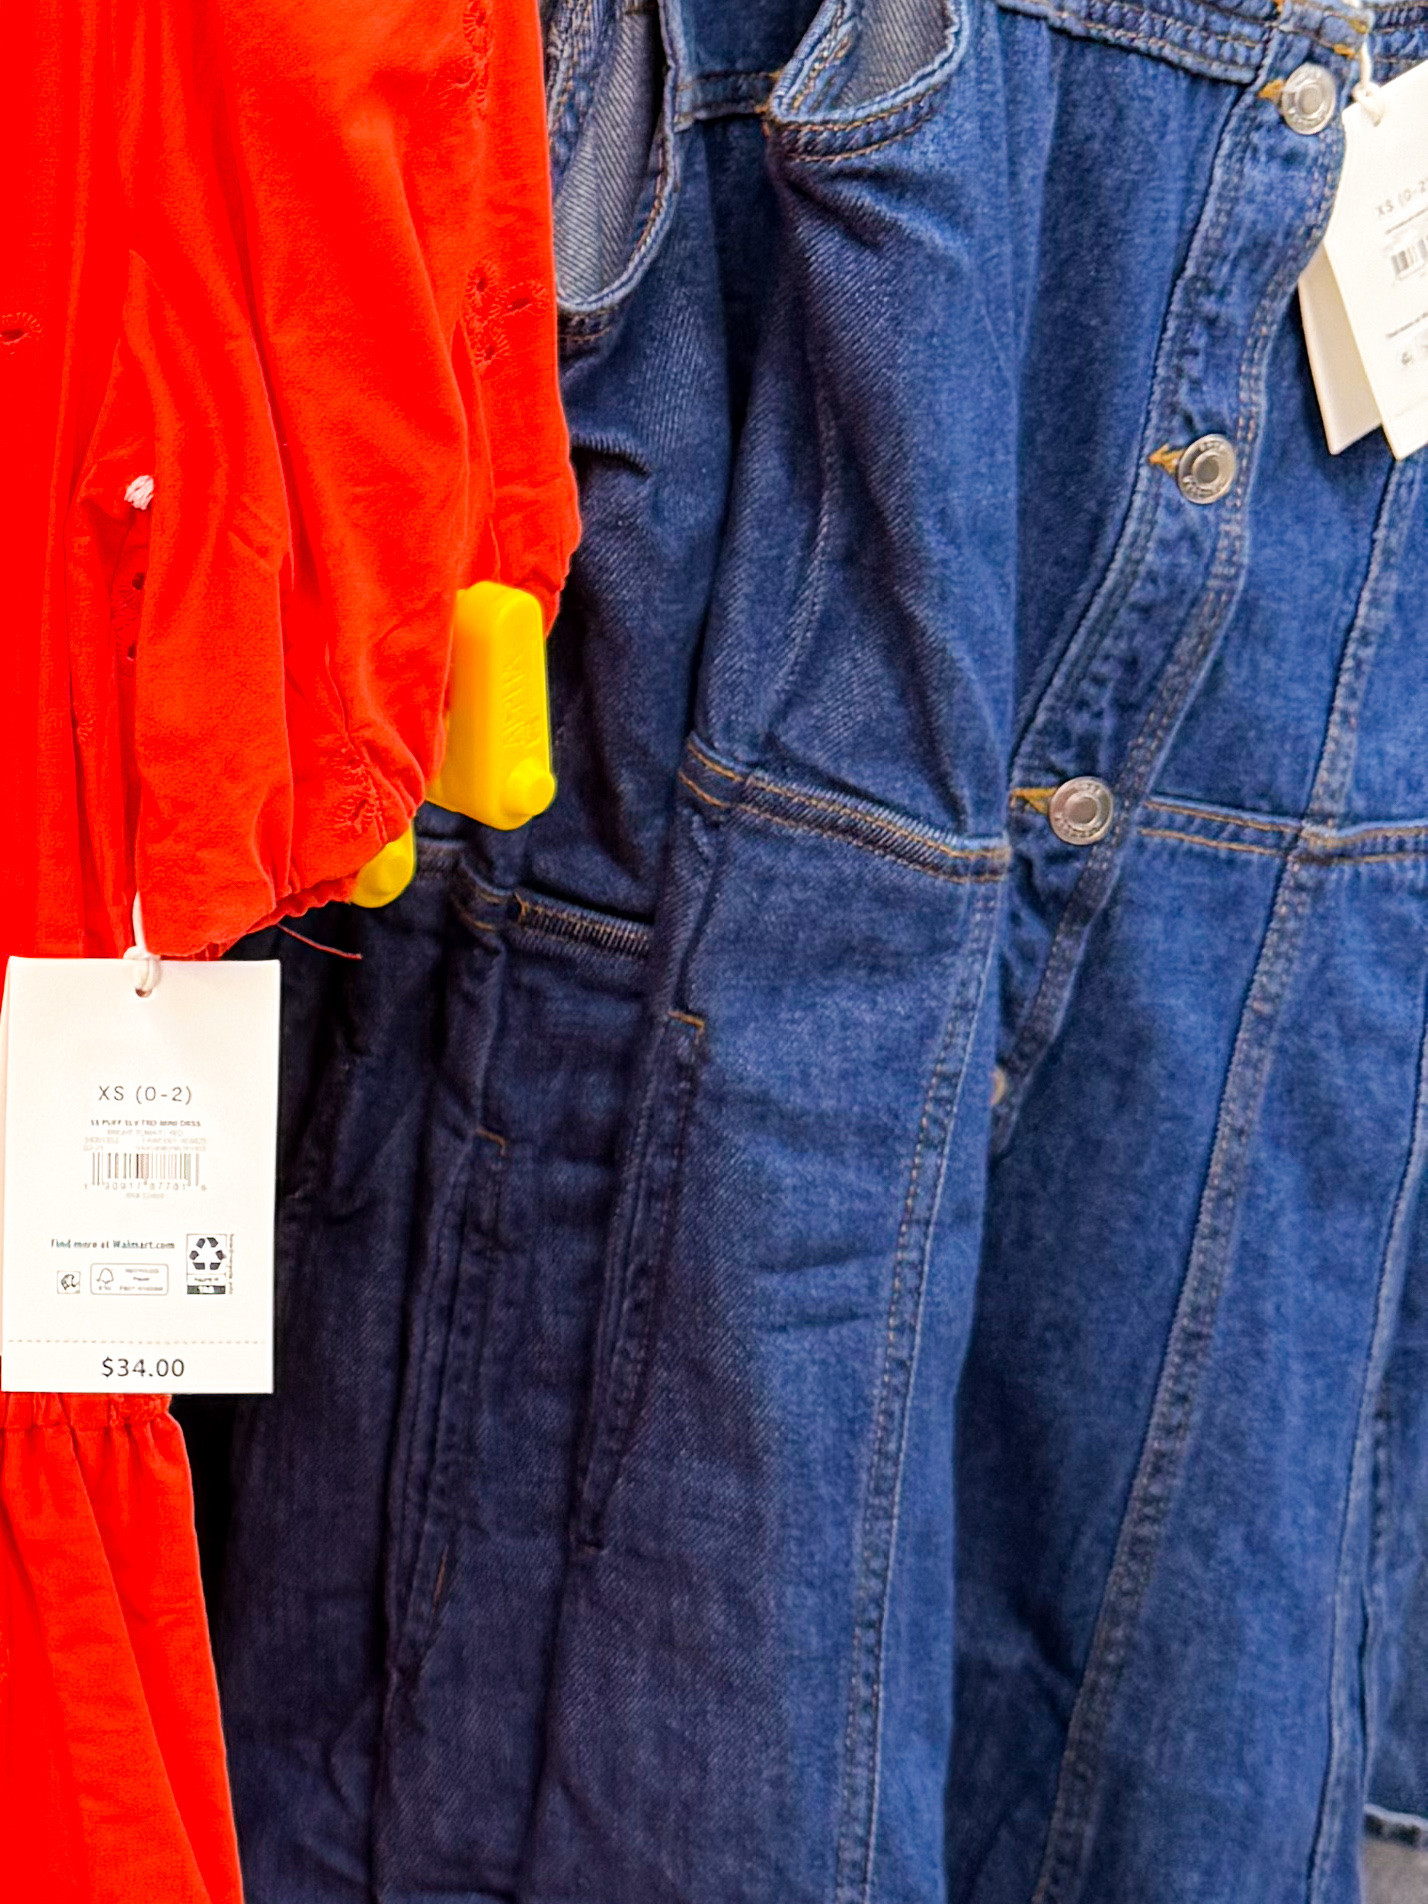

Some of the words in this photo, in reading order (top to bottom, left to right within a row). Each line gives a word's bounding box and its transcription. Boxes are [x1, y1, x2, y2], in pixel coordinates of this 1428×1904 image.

[98, 1085, 125, 1102] XS
[135, 1085, 192, 1105] (0-2)
[73, 1241, 97, 1249] more
[112, 1239, 175, 1250] Walmart.com
[101, 1356, 185, 1378] $34.00
